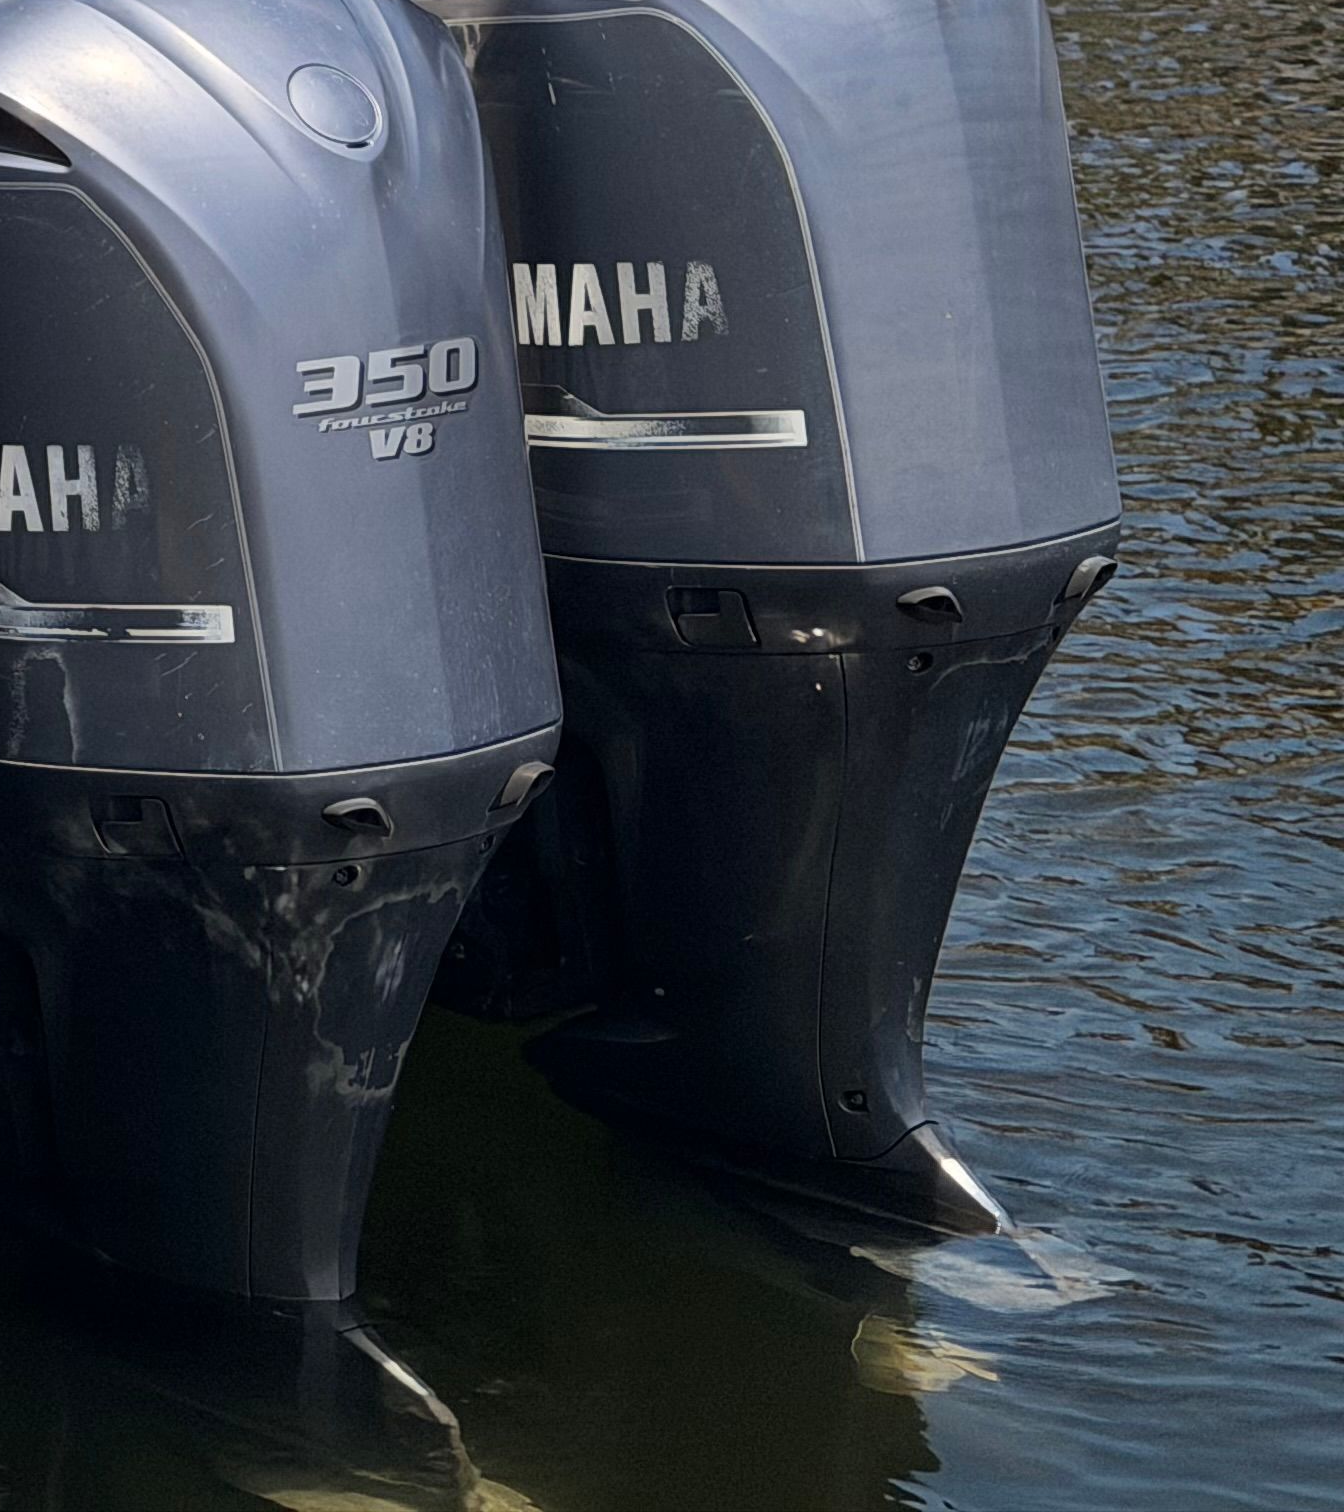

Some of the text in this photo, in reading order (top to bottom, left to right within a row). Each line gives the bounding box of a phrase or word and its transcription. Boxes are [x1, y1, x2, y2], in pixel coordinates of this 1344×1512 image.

[513, 261, 729, 347] MAHA
[292, 337, 479, 418] 350
[318, 400, 469, 433] fourstroke
[369, 422, 436, 462] V8
